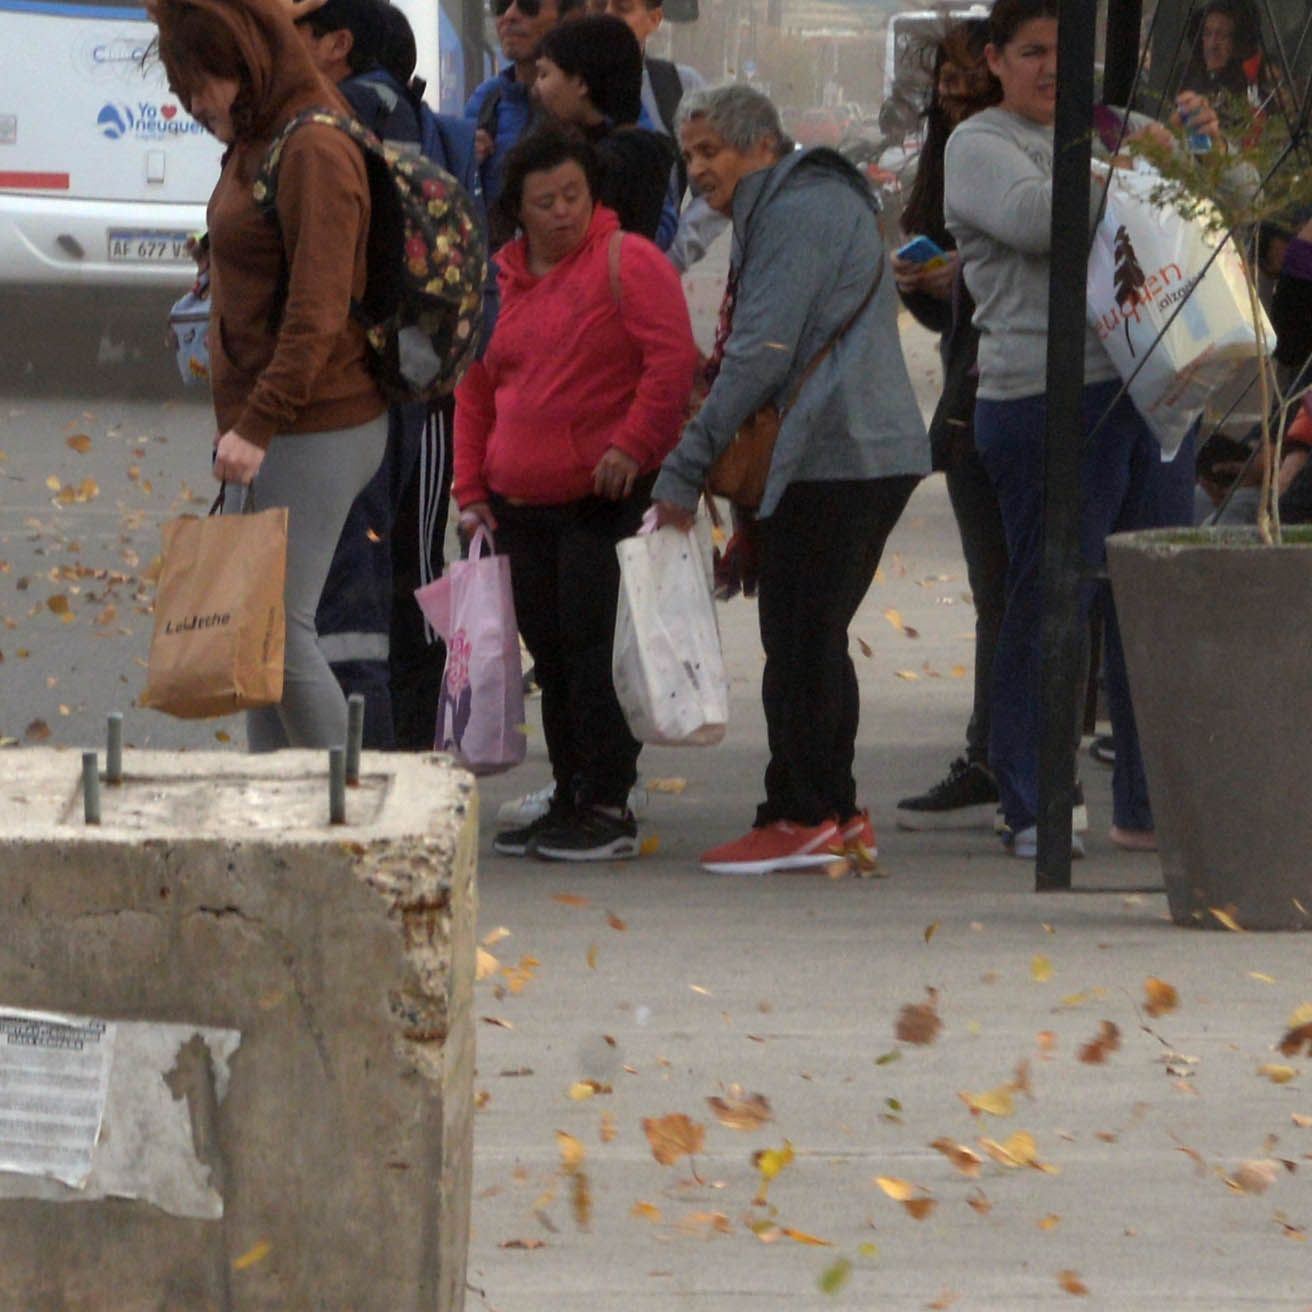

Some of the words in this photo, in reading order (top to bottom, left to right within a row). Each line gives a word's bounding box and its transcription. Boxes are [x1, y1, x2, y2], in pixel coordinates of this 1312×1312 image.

[139, 101, 156, 117] Yo
[113, 240, 129, 257] AF
[138, 240, 166, 257] 677
[1095, 262, 1183, 340] euquen
